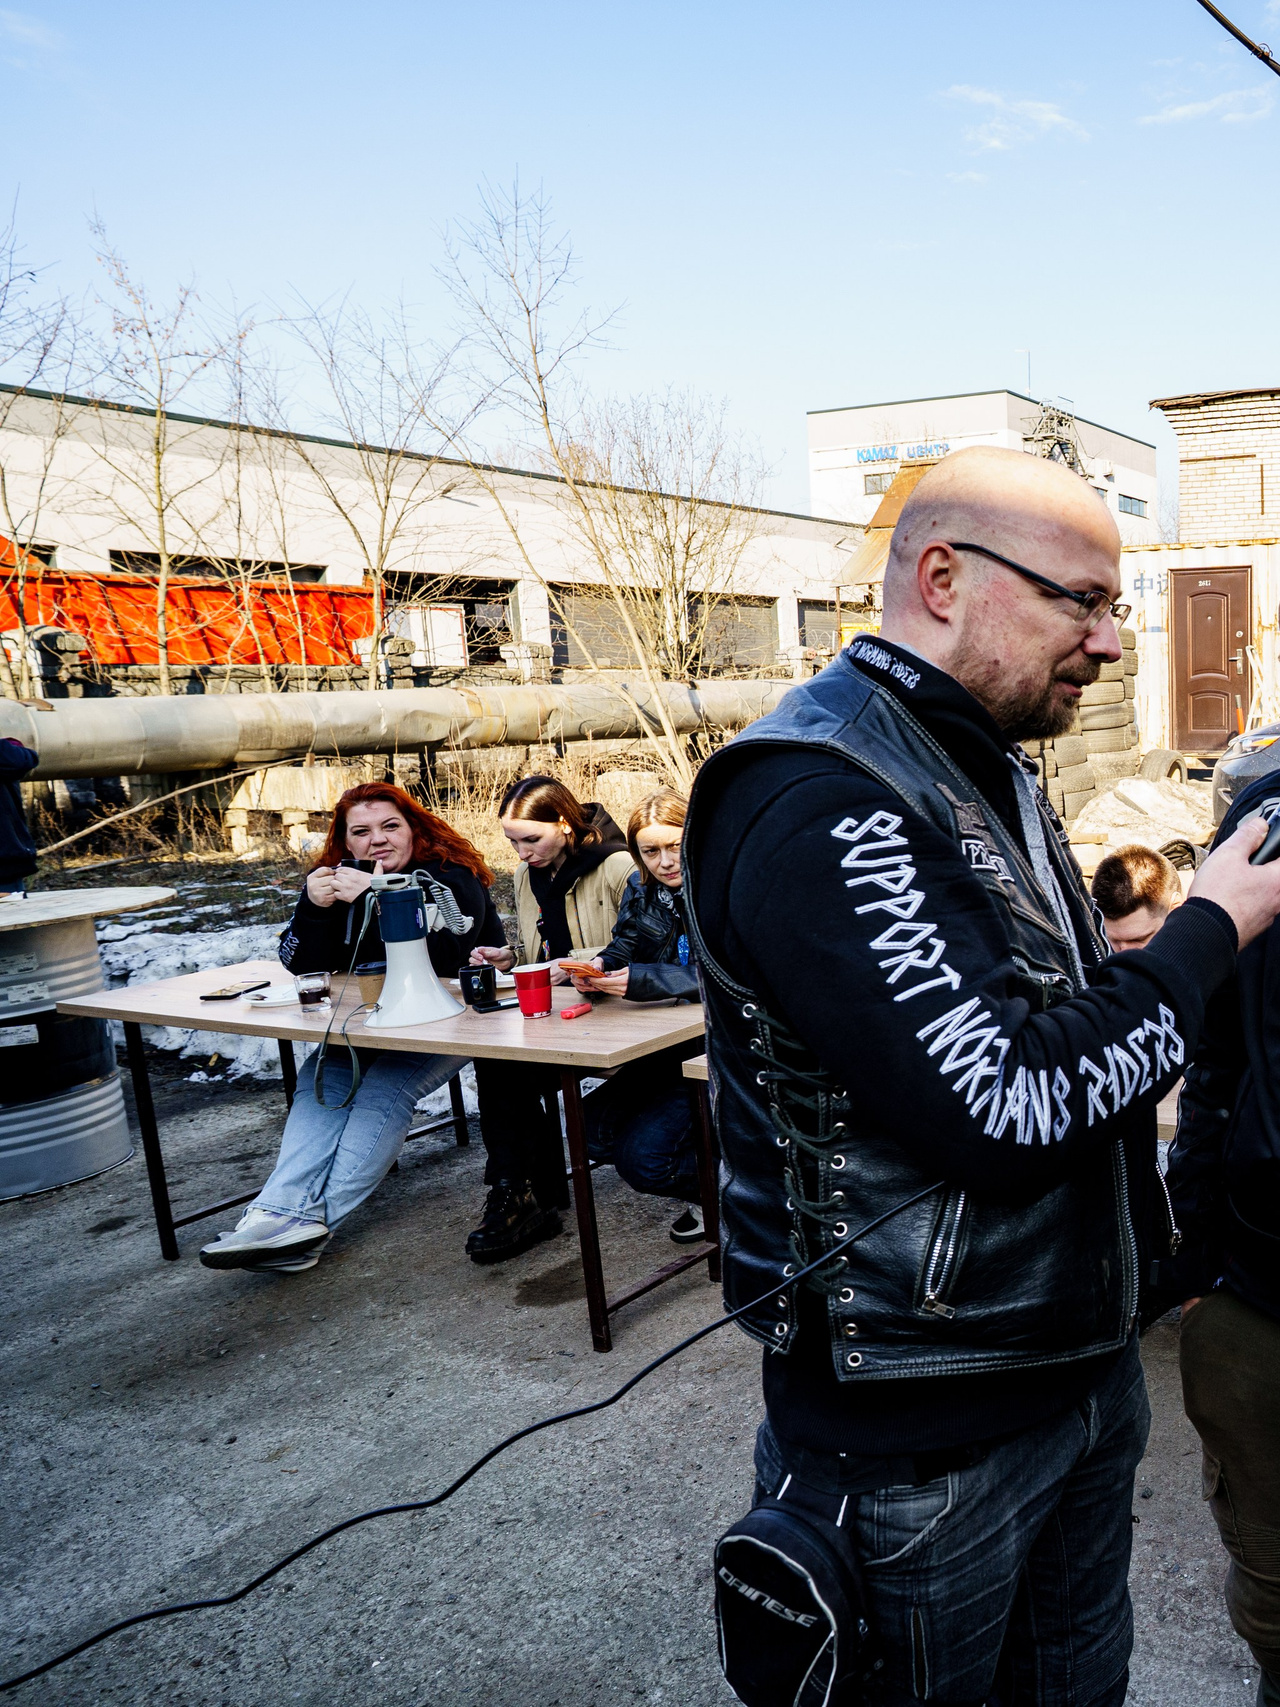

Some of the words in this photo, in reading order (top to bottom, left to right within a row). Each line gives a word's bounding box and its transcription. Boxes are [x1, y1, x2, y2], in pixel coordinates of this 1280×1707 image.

[831, 810, 962, 1002] SUPPORT
[1079, 1002, 1185, 1127] RIDERS
[718, 1566, 818, 1628] DAINESE
